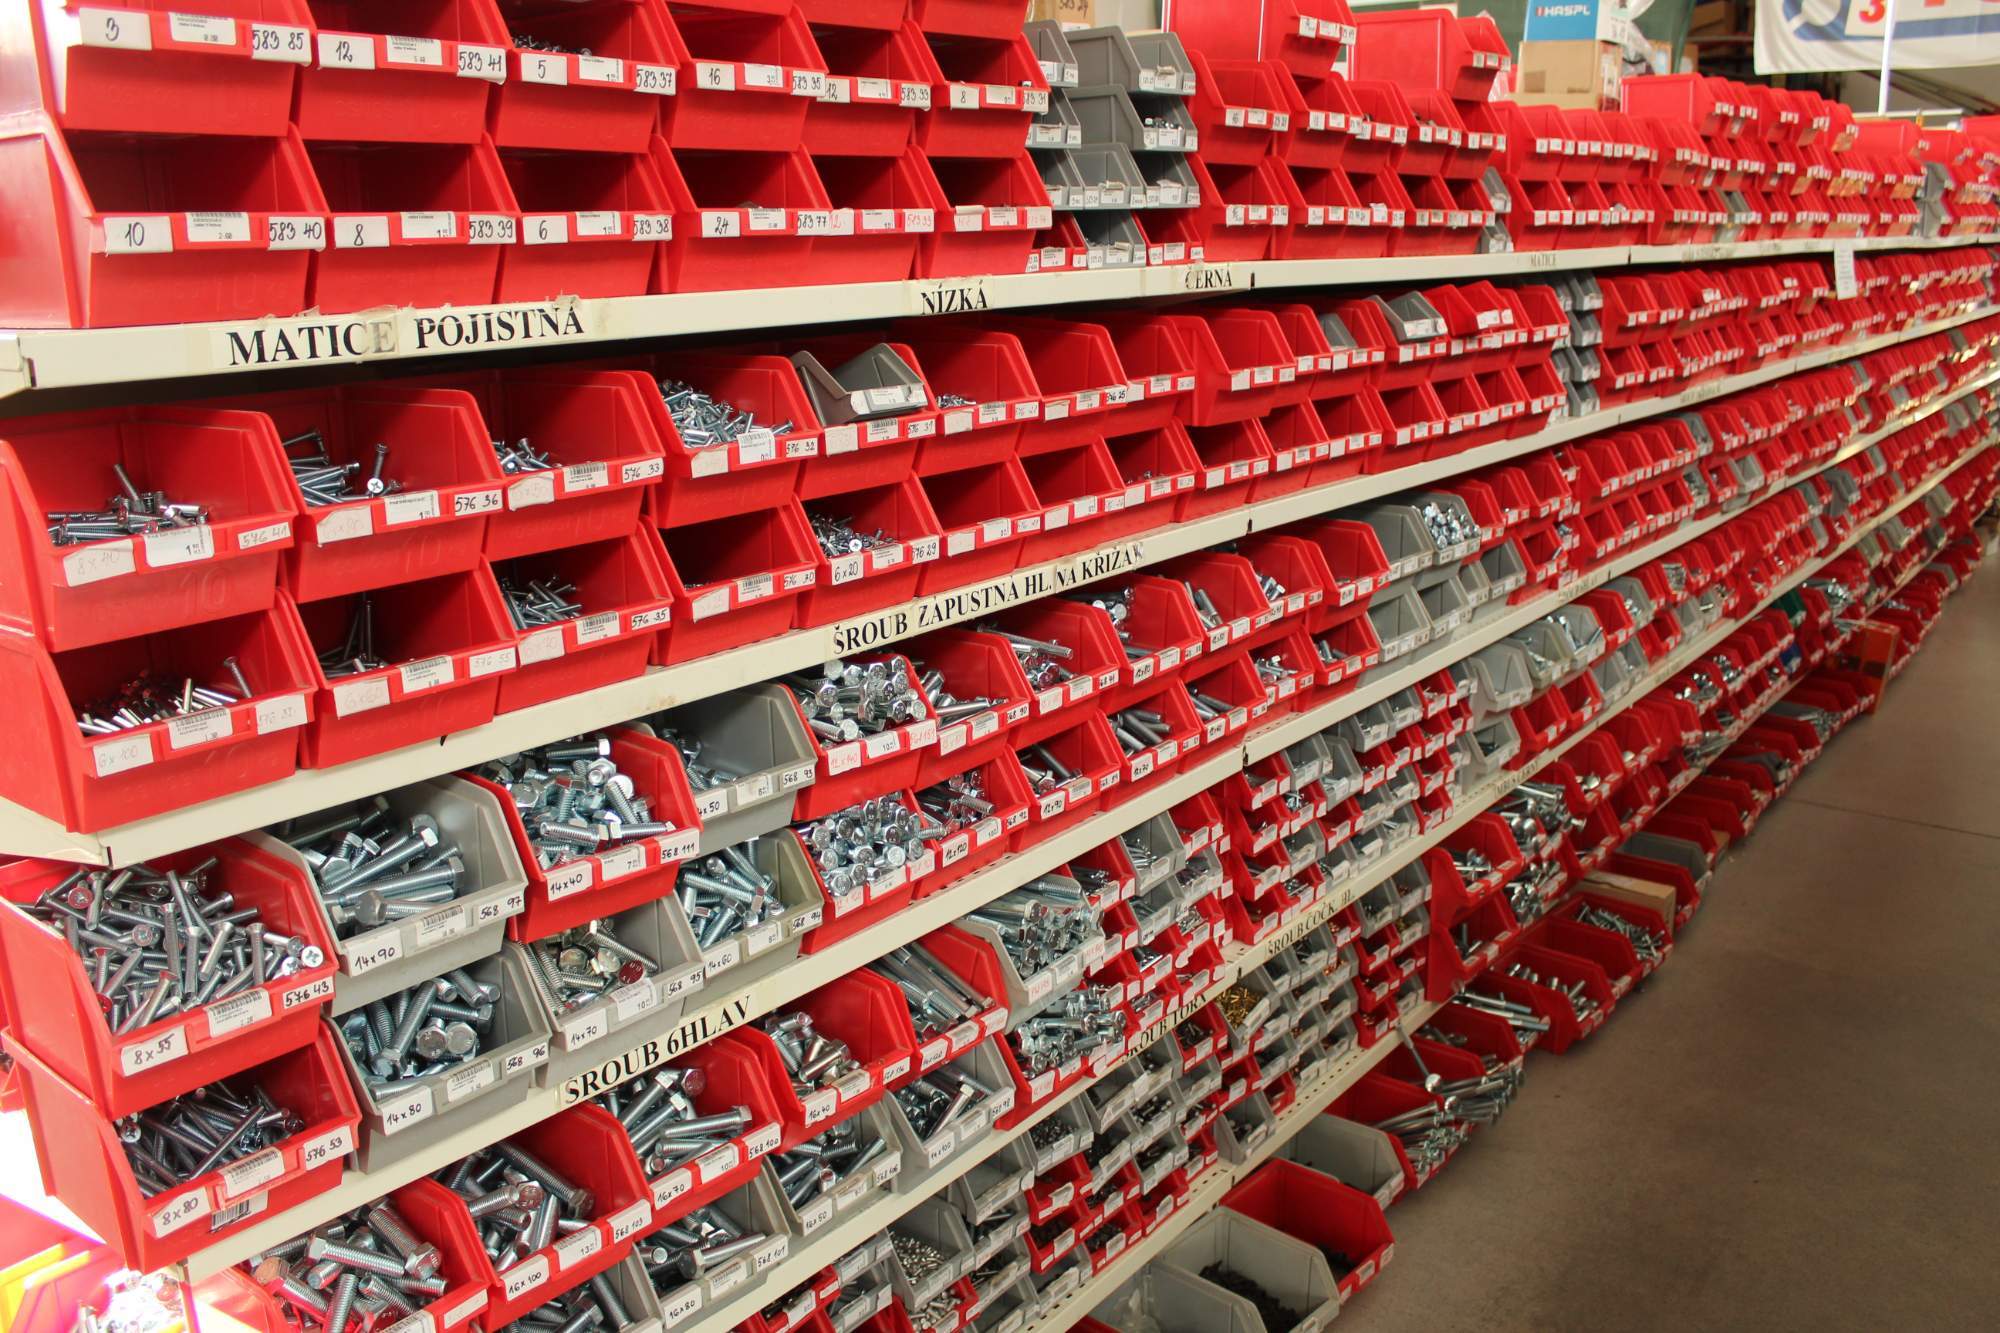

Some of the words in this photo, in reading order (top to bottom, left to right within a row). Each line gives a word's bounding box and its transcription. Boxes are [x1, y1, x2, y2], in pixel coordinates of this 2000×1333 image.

[1544, 5, 1591, 16] HASPL
[288, 33, 304, 50] 85
[335, 41, 353, 63] 12
[459, 51, 483, 72] 583
[488, 54, 502, 73] 41
[537, 60, 547, 79] 5
[636, 69, 657, 88] 583
[660, 71, 673, 89] 37
[708, 67, 721, 86] 16
[792, 76, 809, 94] 583
[825, 82, 838, 101] 12
[122, 222, 145, 247] 10
[269, 221, 297, 244] 583
[303, 221, 323, 242] 40
[468, 220, 494, 243] 583
[497, 219, 514, 243] 39
[540, 219, 550, 246] 6
[655, 217, 670, 239] 38
[714, 216, 730, 236] 24
[797, 212, 815, 235] 583
[353, 223, 365, 247] 8
[1185, 263, 1233, 291] ČERNÁ
[920, 281, 988, 316] NÍZKÁ
[623, 466, 641, 487] 576
[648, 462, 661, 477] 33
[455, 495, 476, 513] 576
[482, 493, 498, 508] 36
[925, 542, 936, 561] 29
[833, 611, 908, 655] ŠROUB
[1025, 568, 1052, 600] HL.
[1055, 563, 1077, 587] NA
[631, 616, 649, 633] 576
[654, 608, 668, 625] 35
[784, 772, 799, 786] 568
[804, 768, 814, 780] 93
[661, 845, 679, 862] 568
[549, 872, 584, 896] 14x40
[479, 905, 500, 922] 568
[354, 945, 397, 972] 14x90
[284, 987, 311, 1007] 576
[312, 979, 331, 996] 43
[668, 980, 684, 998] 568
[666, 994, 752, 1055] 6HLAV
[505, 1057, 524, 1073] 568
[305, 1146, 326, 1165] 576
[328, 1136, 343, 1152] 53
[748, 1144, 764, 1162] 568
[656, 1183, 685, 1202] 16x70
[614, 1223, 630, 1241] 568
[508, 1270, 544, 1294] 16x100
